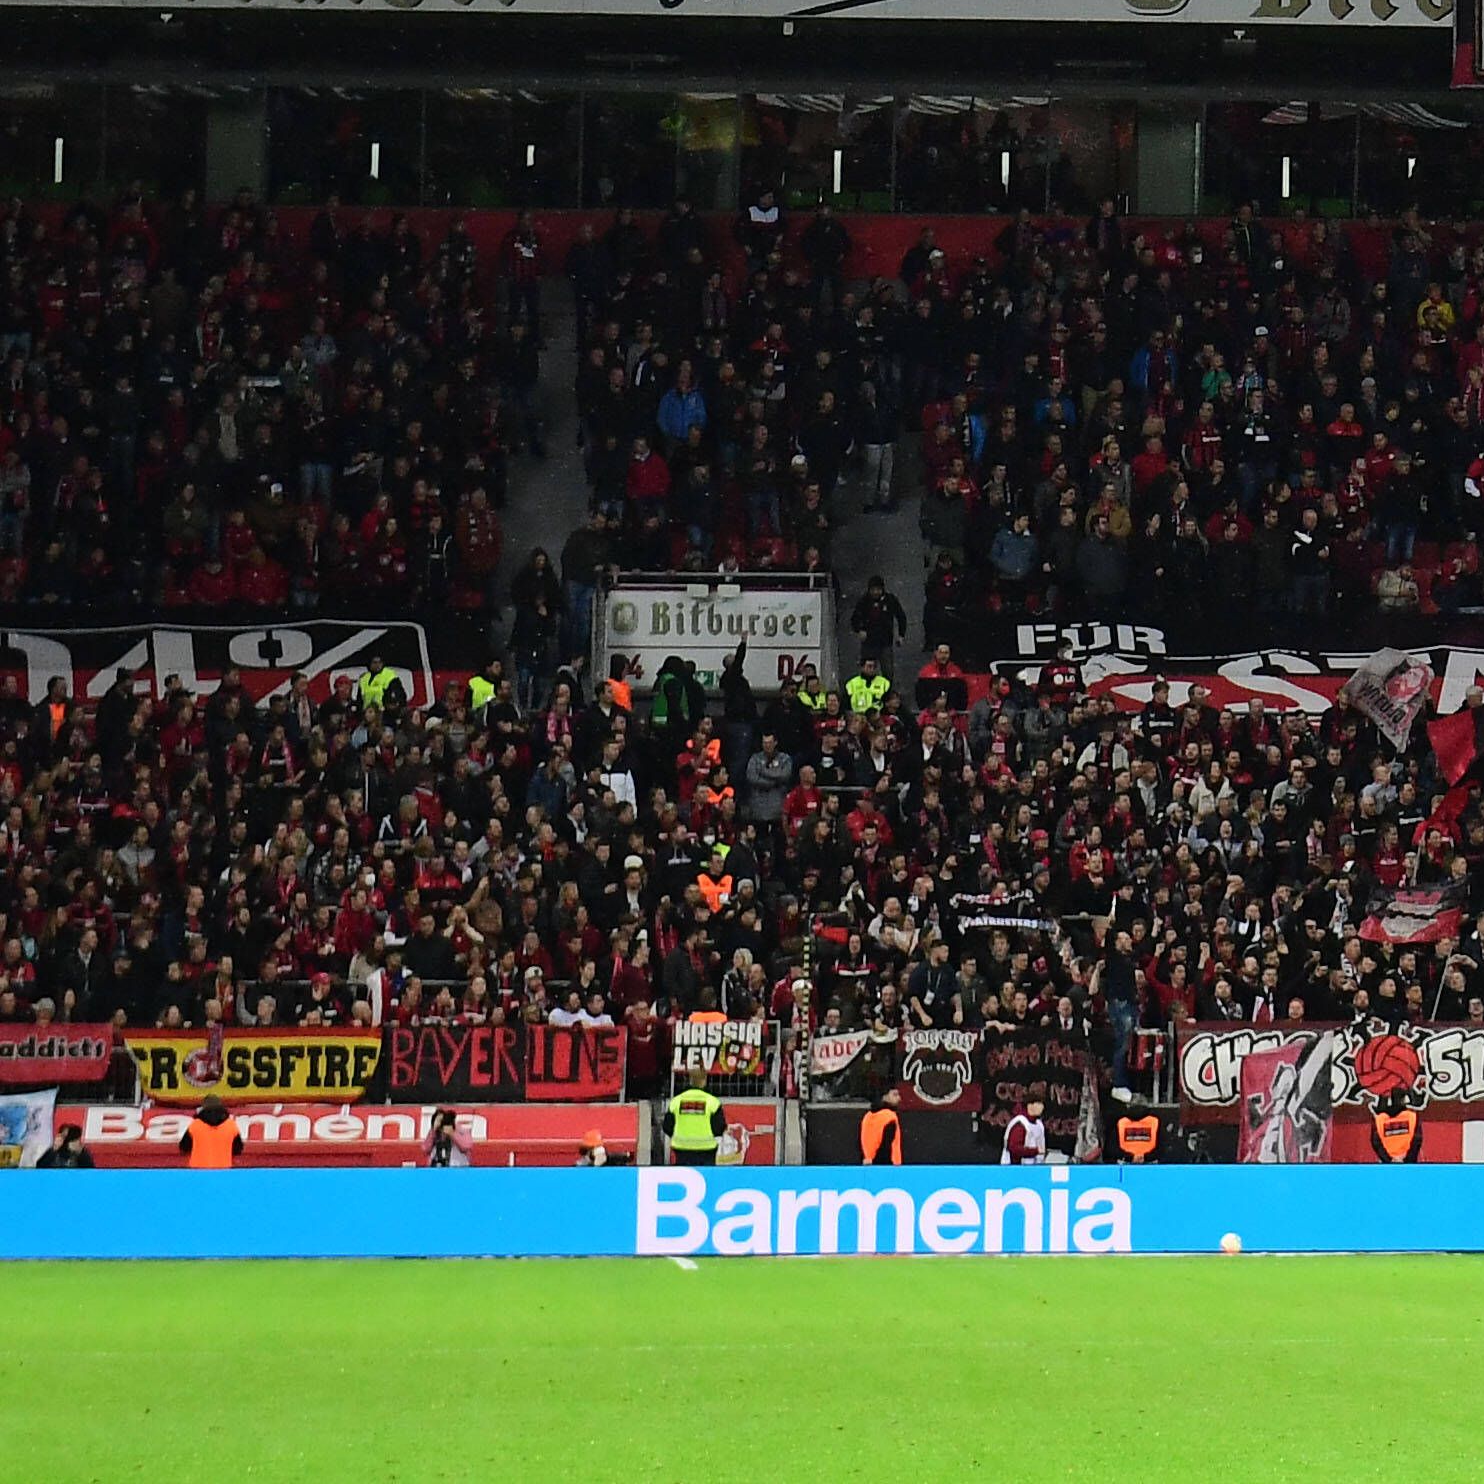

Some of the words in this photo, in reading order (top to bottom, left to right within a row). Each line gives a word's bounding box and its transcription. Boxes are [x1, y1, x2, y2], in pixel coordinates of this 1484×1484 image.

[647, 601, 814, 647] Bitburger
[1016, 622, 1167, 657] FÜR
[675, 1022, 762, 1046] HASSIA
[390, 1026, 519, 1088] BAYER
[675, 1046, 717, 1071] LEV
[84, 1104, 488, 1144] Bamenia
[636, 1166, 1132, 1255] Barmenia
